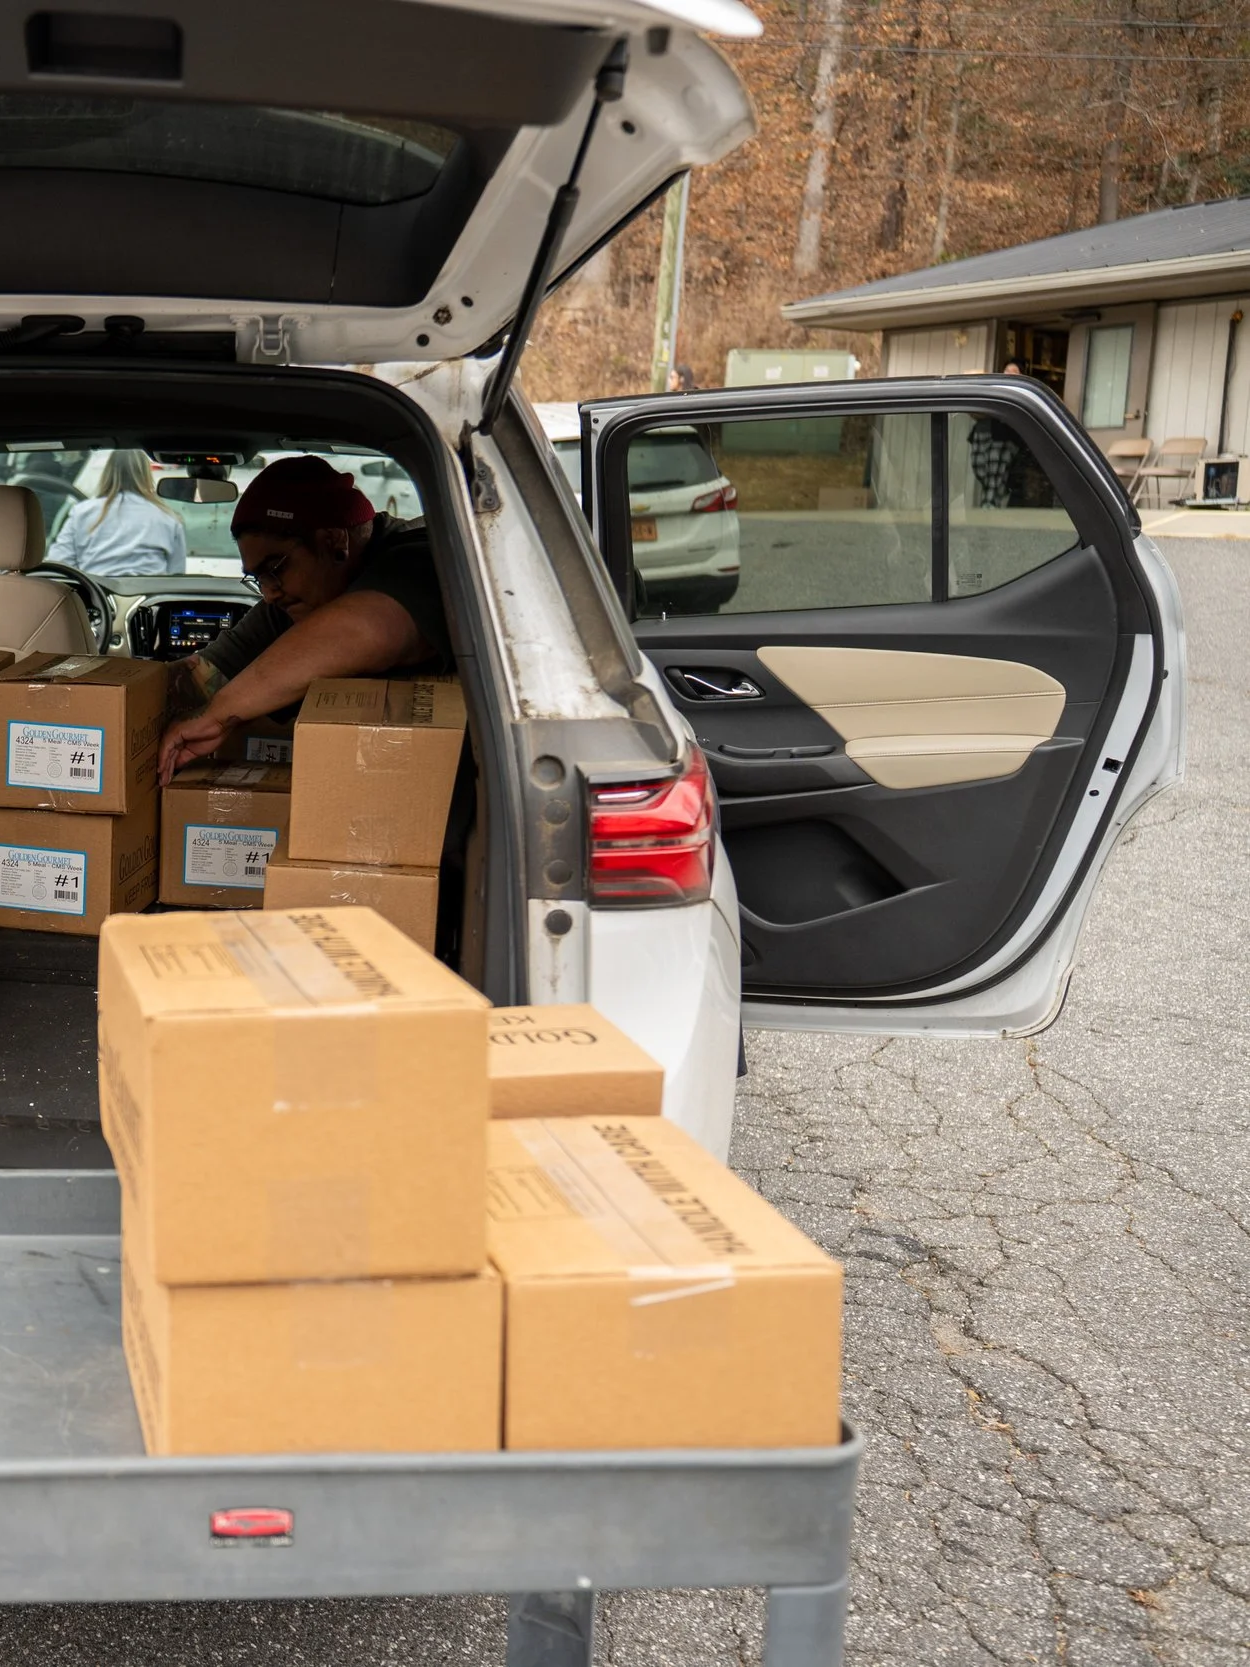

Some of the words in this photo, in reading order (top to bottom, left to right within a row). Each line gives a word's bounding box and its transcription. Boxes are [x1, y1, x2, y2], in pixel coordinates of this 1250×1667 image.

[15, 736, 34, 745] 4324
[70, 751, 95, 765] #1
[192, 838, 210, 846] 4324
[245, 851, 270, 863] #1
[1, 859, 19, 867] 4324
[54, 874, 79, 888] #1
